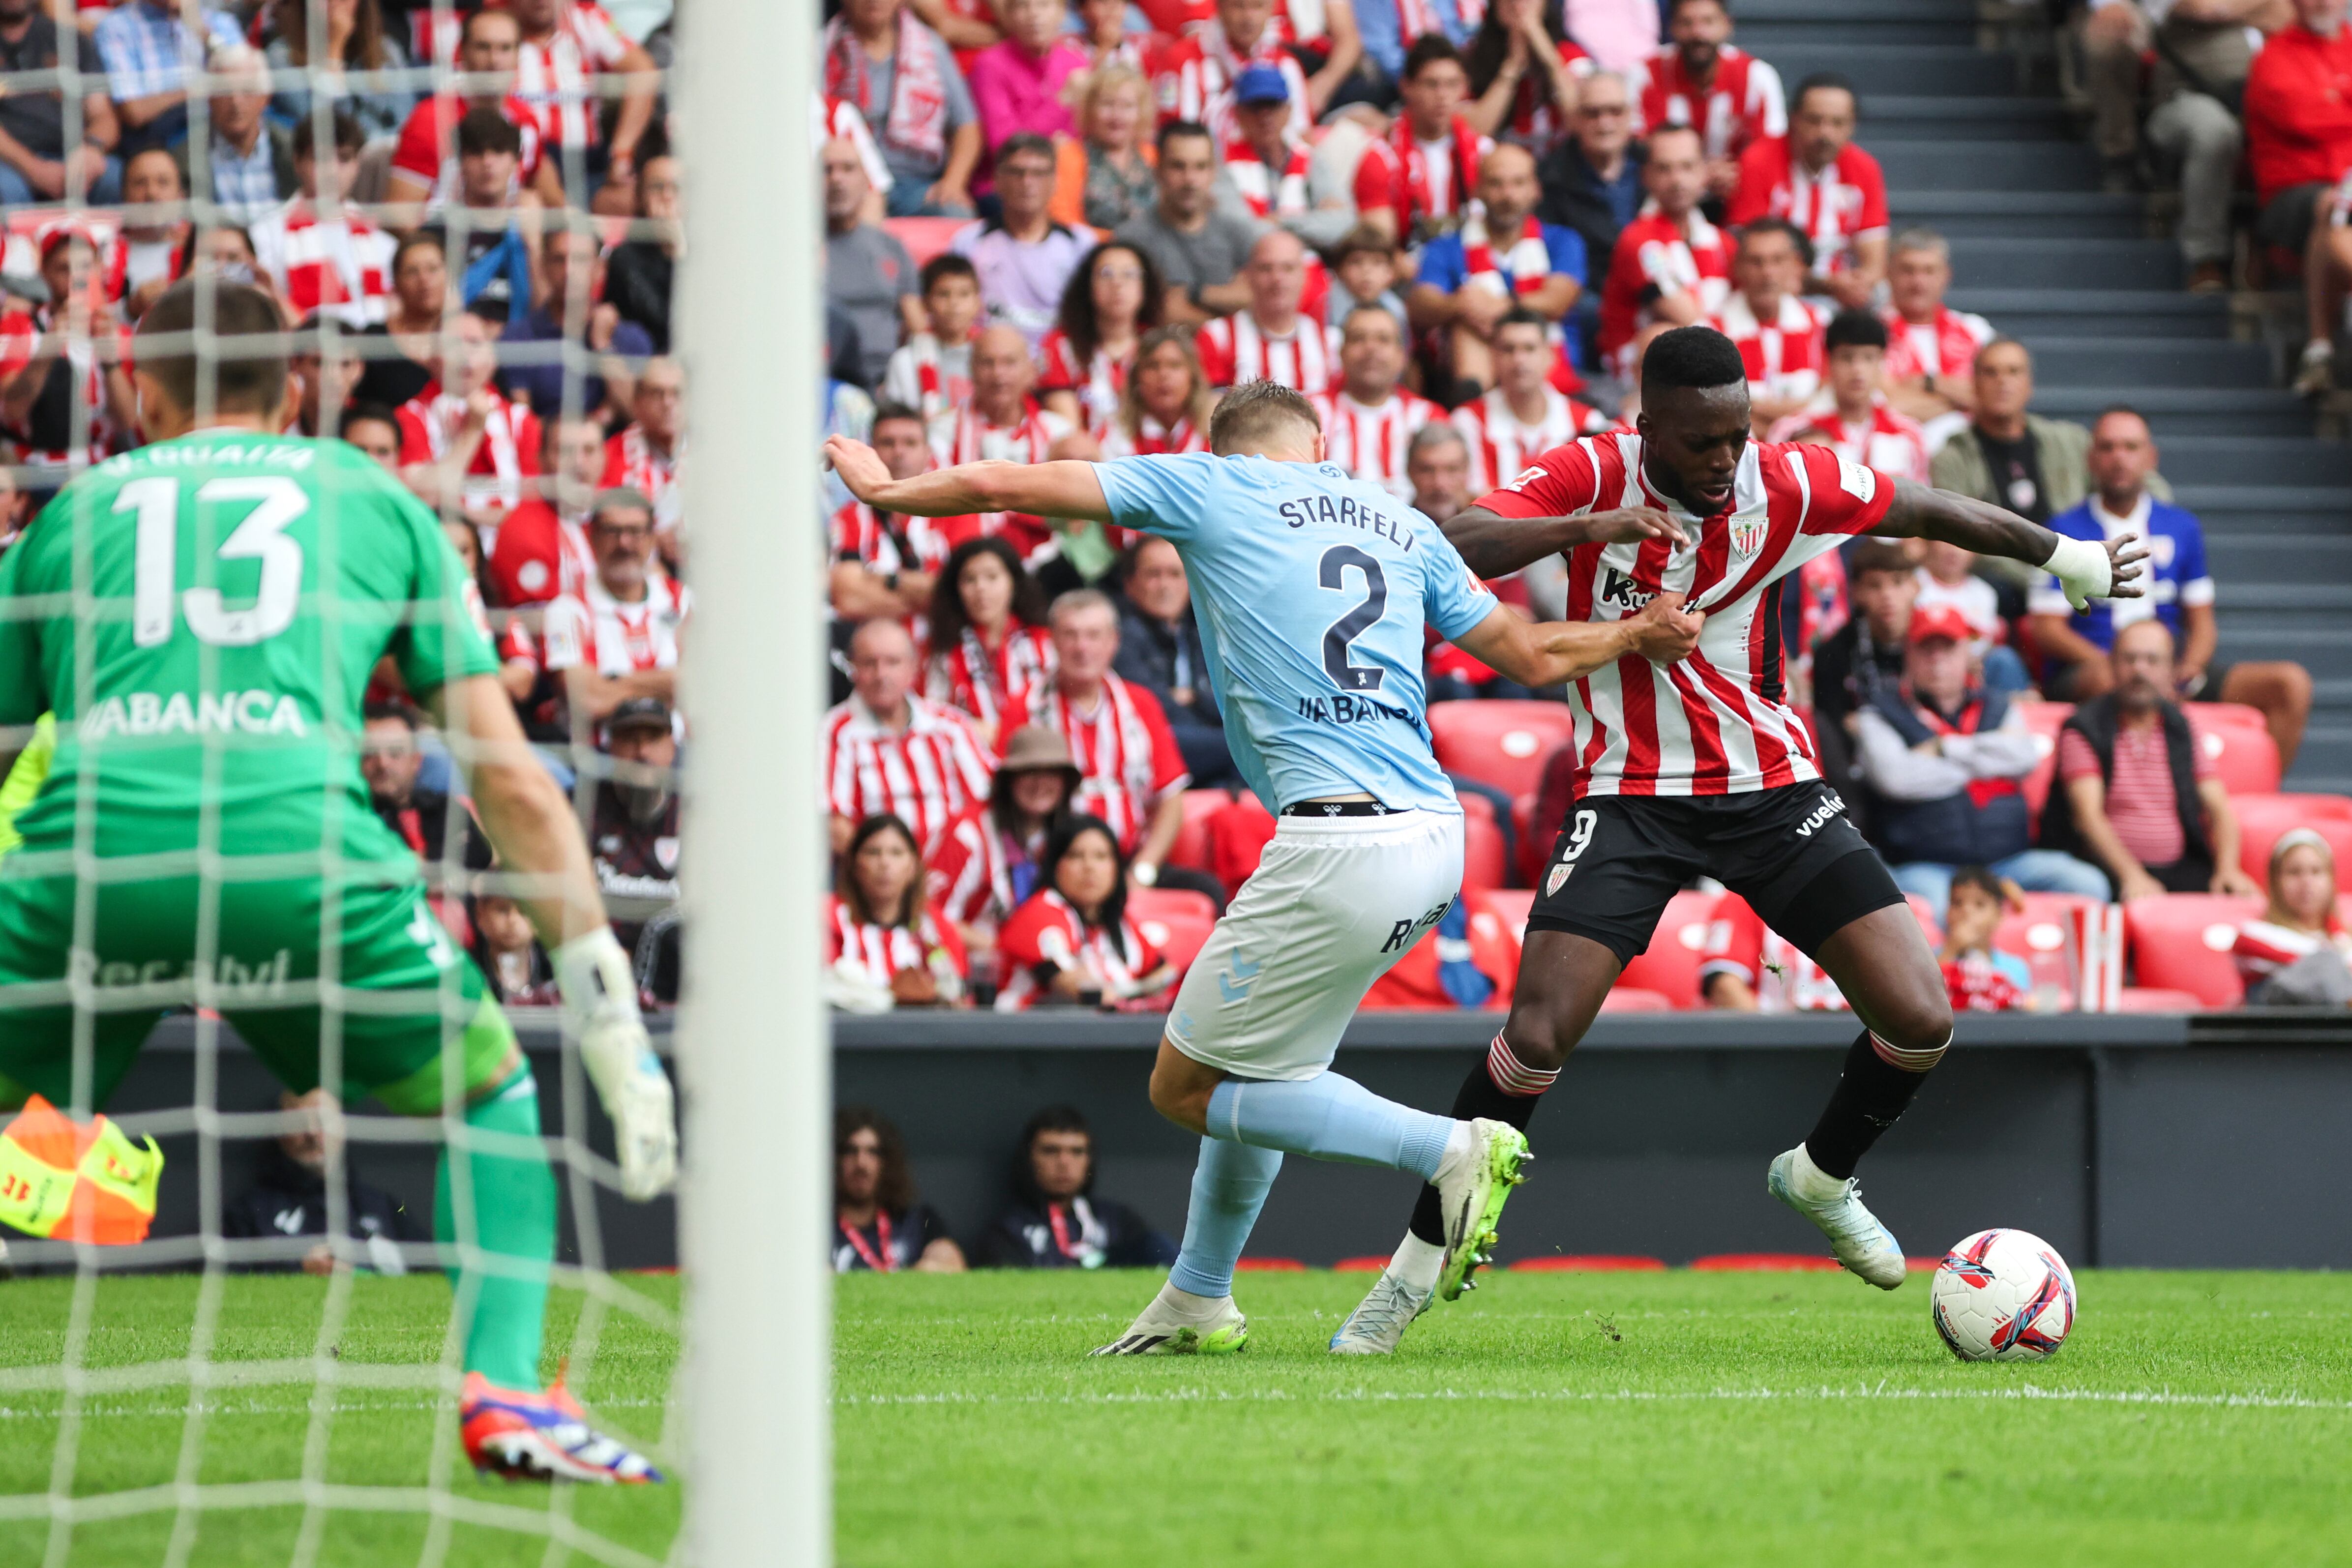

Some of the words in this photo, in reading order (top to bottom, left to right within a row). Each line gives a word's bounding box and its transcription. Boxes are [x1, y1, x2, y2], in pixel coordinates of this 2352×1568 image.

[1279, 495, 1416, 553] STARFELT
[111, 475, 311, 648] 13
[1738, 548, 1757, 561] BILBAO
[1318, 543, 1389, 692] 2
[91, 689, 307, 738] ABANCA
[1563, 810, 1598, 861] 9
[1944, 1313, 1960, 1339] LALIGA
